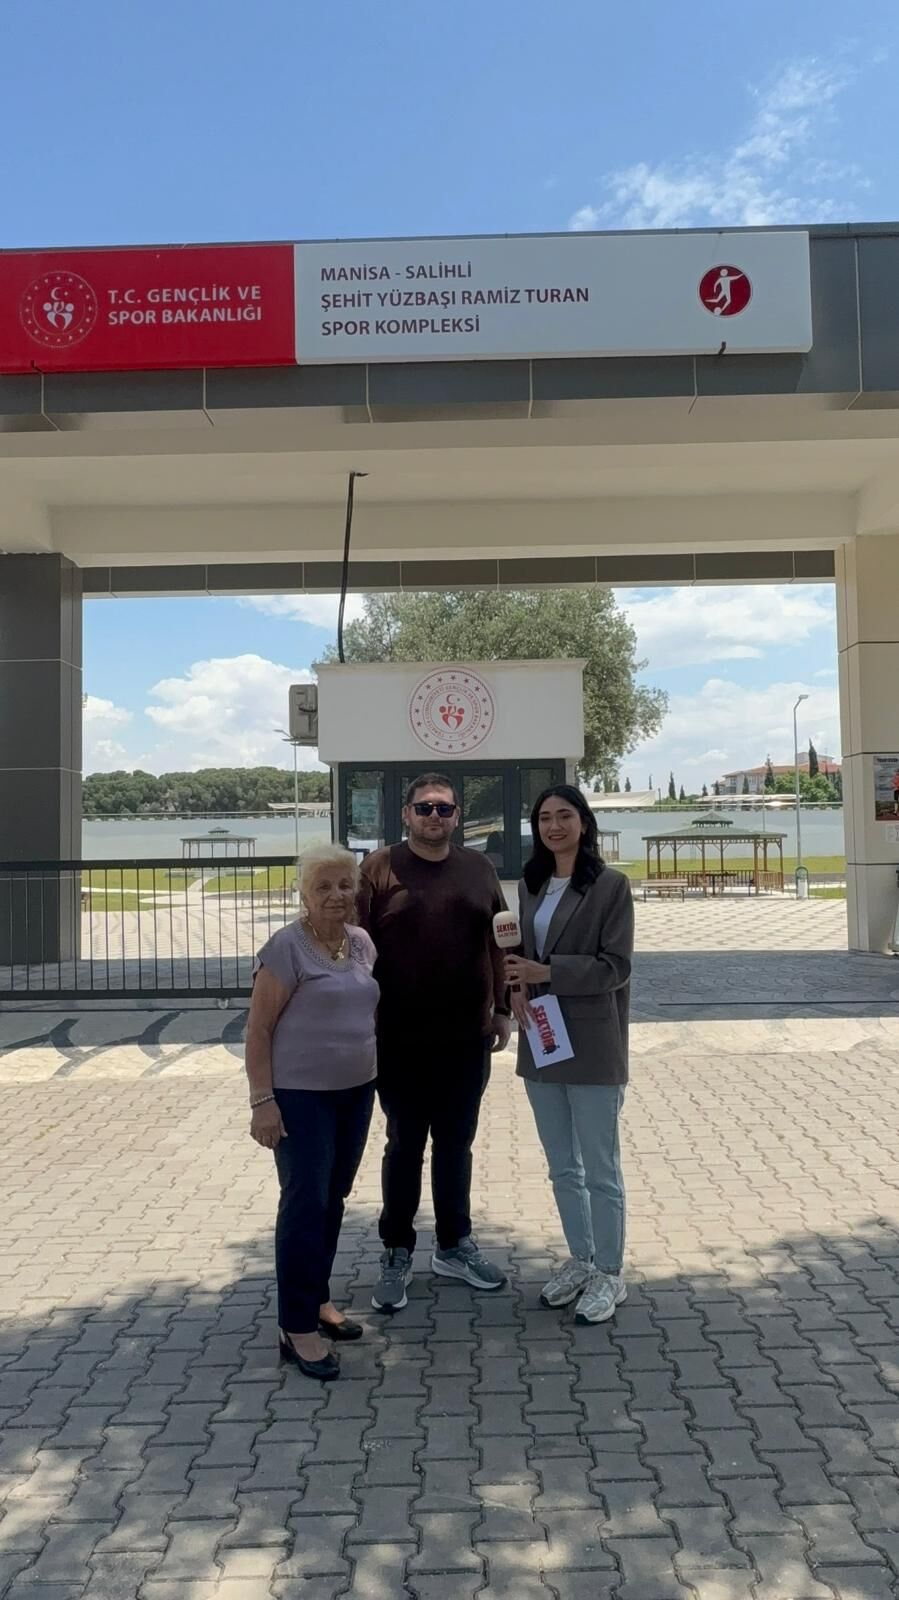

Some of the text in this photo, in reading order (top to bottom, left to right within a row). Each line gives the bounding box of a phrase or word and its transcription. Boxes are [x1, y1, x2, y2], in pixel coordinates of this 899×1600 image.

[321, 264, 390, 281] MANİSA
[405, 261, 472, 279] SALİHLİ
[108, 284, 261, 305] T.C. GENÇLİK VE
[321, 286, 589, 312] ŞEHİT YÜZBAŞI RAMİZ TURAN
[108, 305, 262, 325] SPOR BAKANLIĞI
[322, 315, 480, 336] SPOR KOMPLEKSİ
